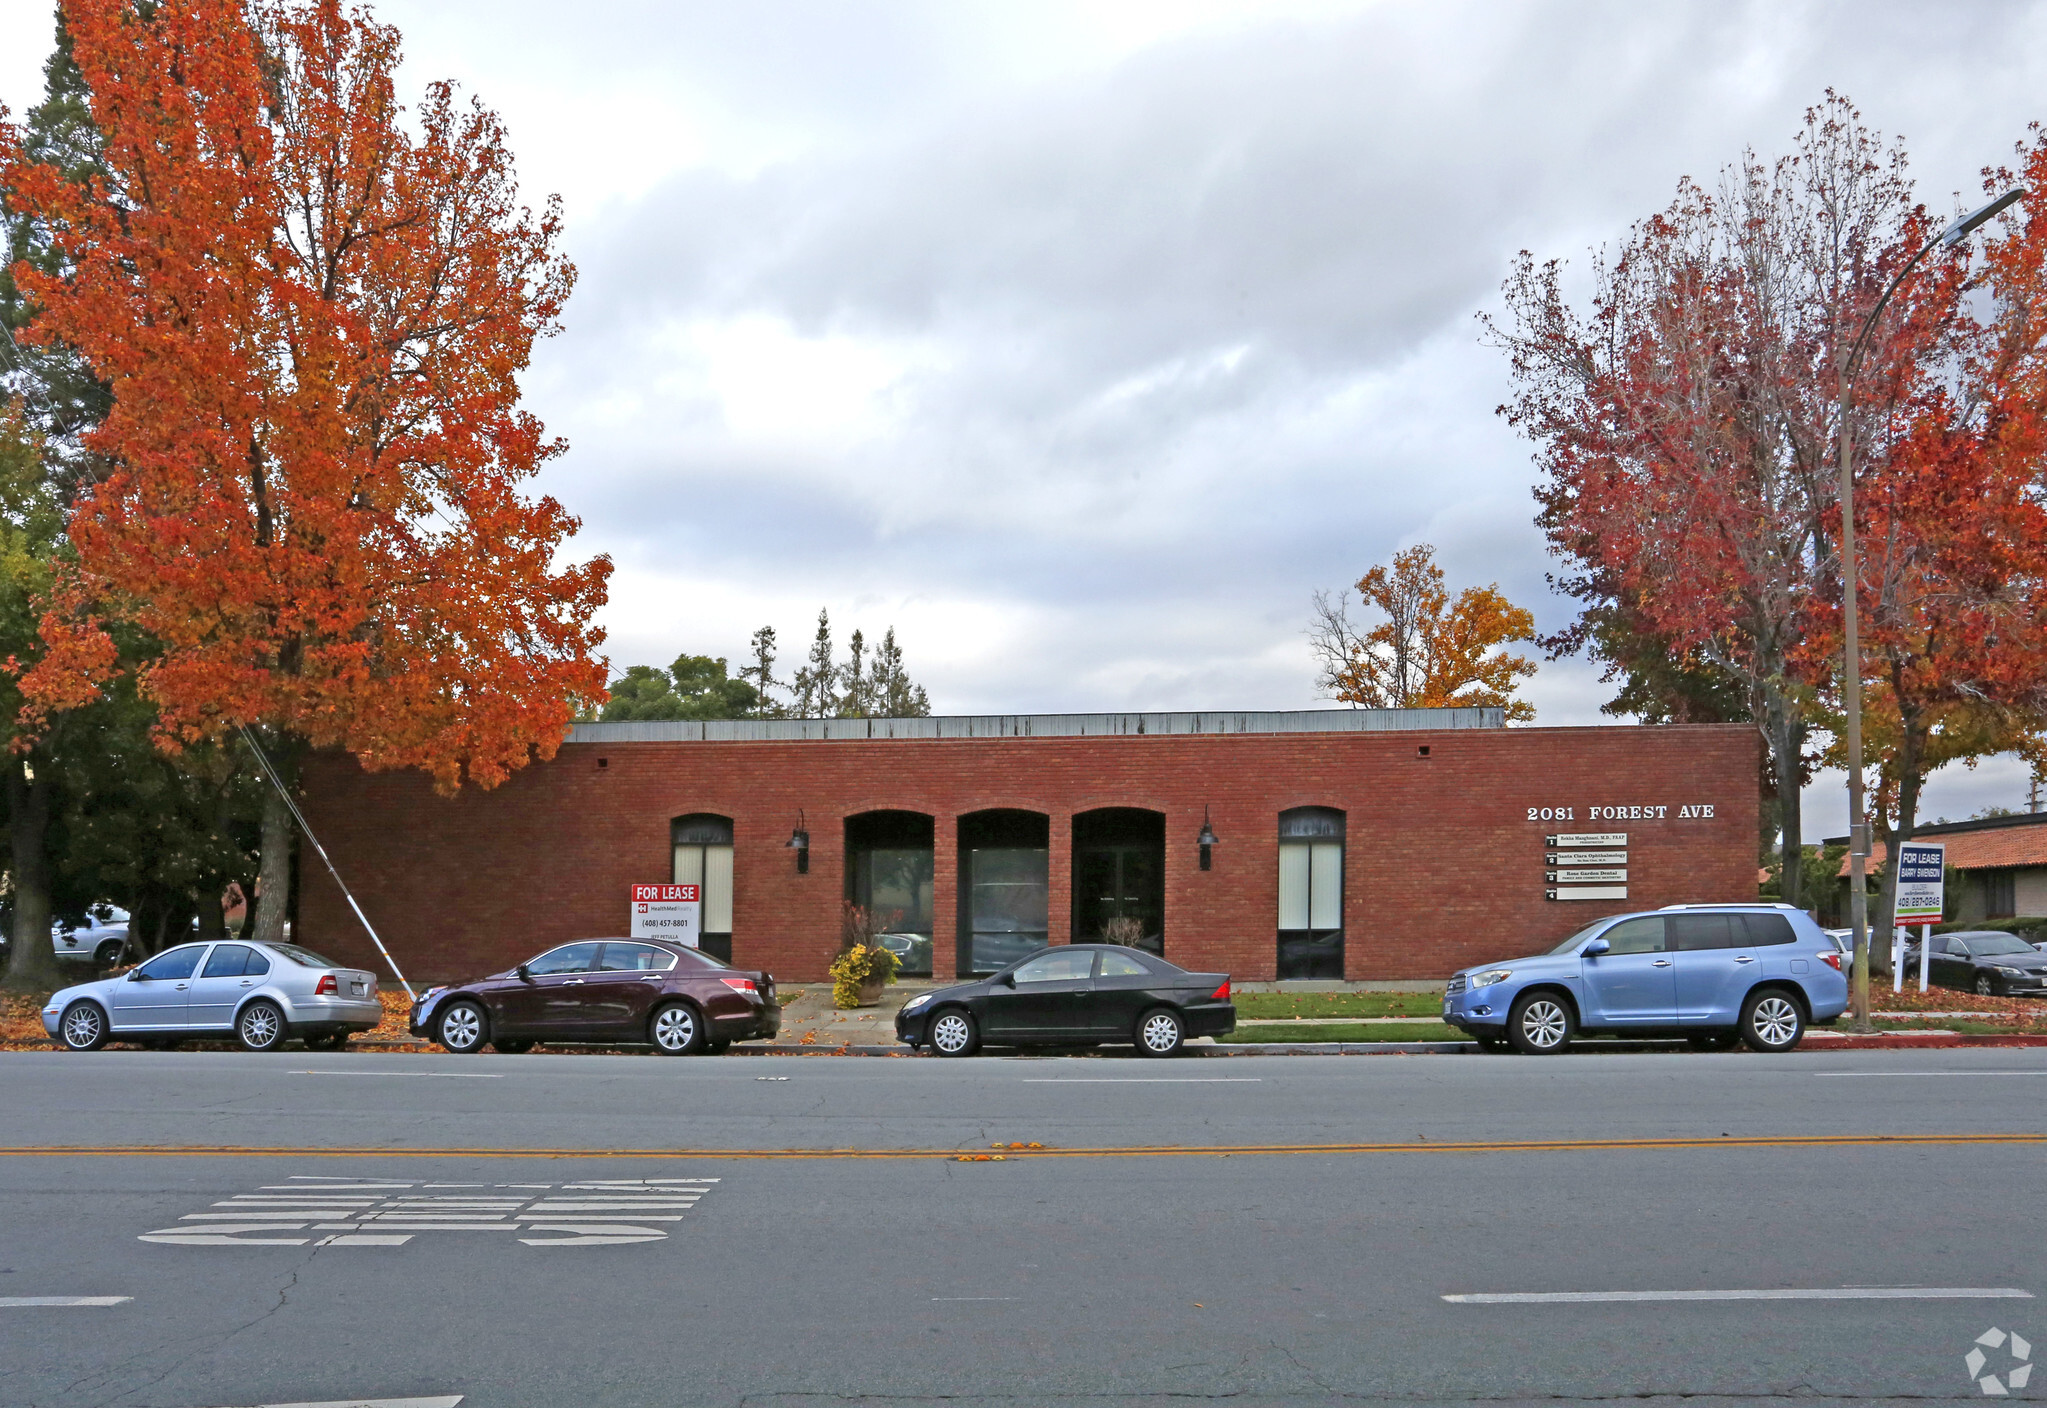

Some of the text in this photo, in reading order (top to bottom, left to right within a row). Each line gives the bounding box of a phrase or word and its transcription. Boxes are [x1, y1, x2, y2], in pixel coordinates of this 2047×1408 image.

[1527, 804, 1714, 821] 2081 FOREST AVE
[1902, 853, 1940, 864] FOR LEASE
[1901, 867, 1940, 878] BARRY SWENSON
[636, 886, 695, 900] FOR LEASE
[642, 919, 688, 928] (408) 457-8801
